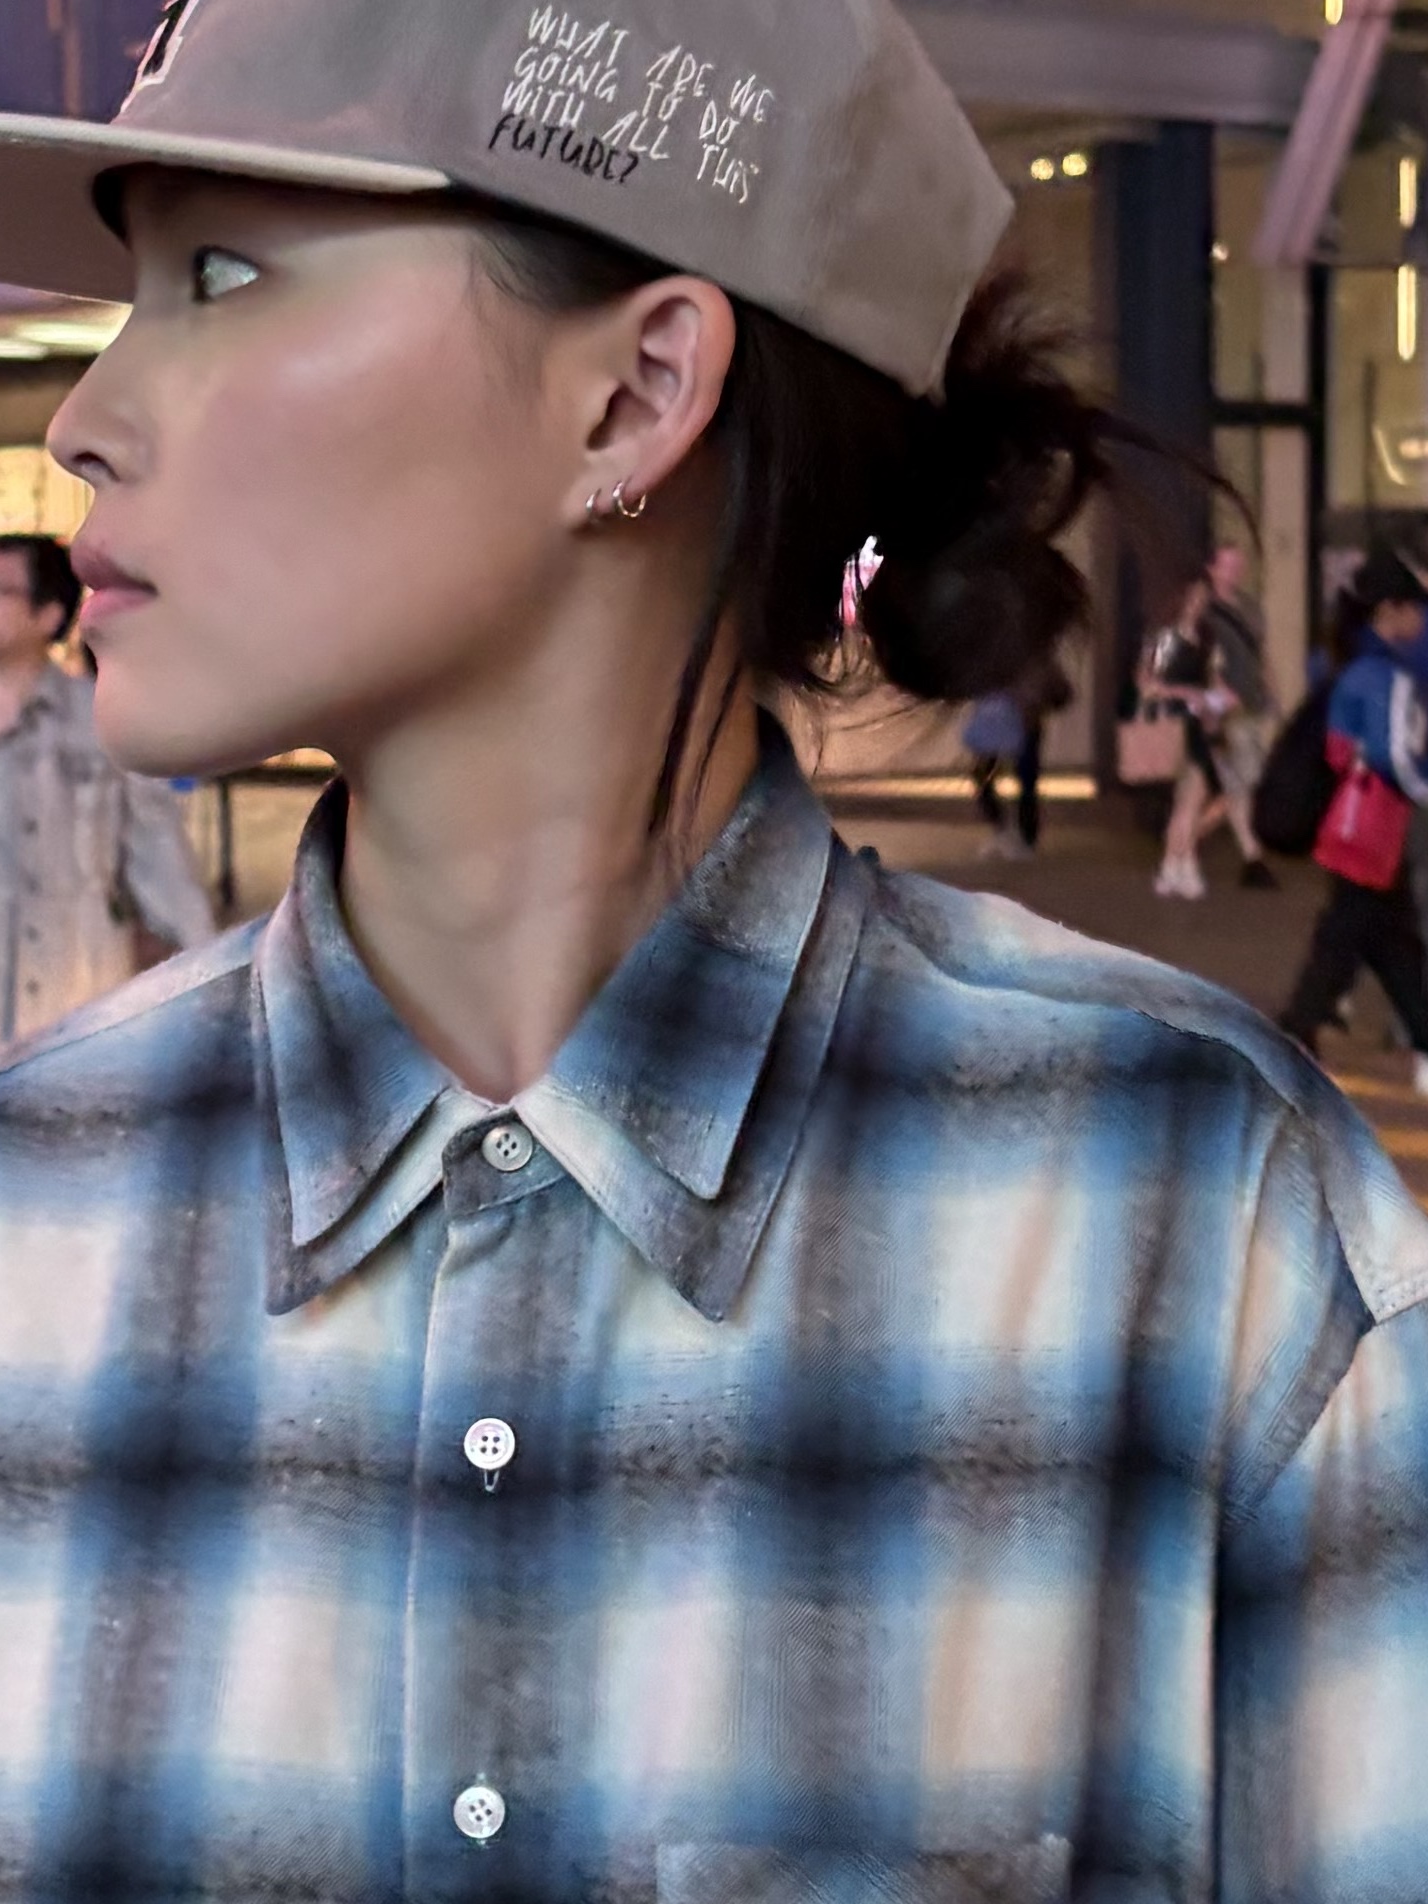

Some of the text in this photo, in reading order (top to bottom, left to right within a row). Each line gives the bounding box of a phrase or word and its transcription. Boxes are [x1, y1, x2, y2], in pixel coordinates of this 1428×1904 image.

[514, 46, 740, 145] GOING TO DO
[527, 4, 629, 68] WHAT
[730, 74, 775, 124] WE
[501, 80, 585, 127] WITH
[601, 110, 670, 160] ALL
